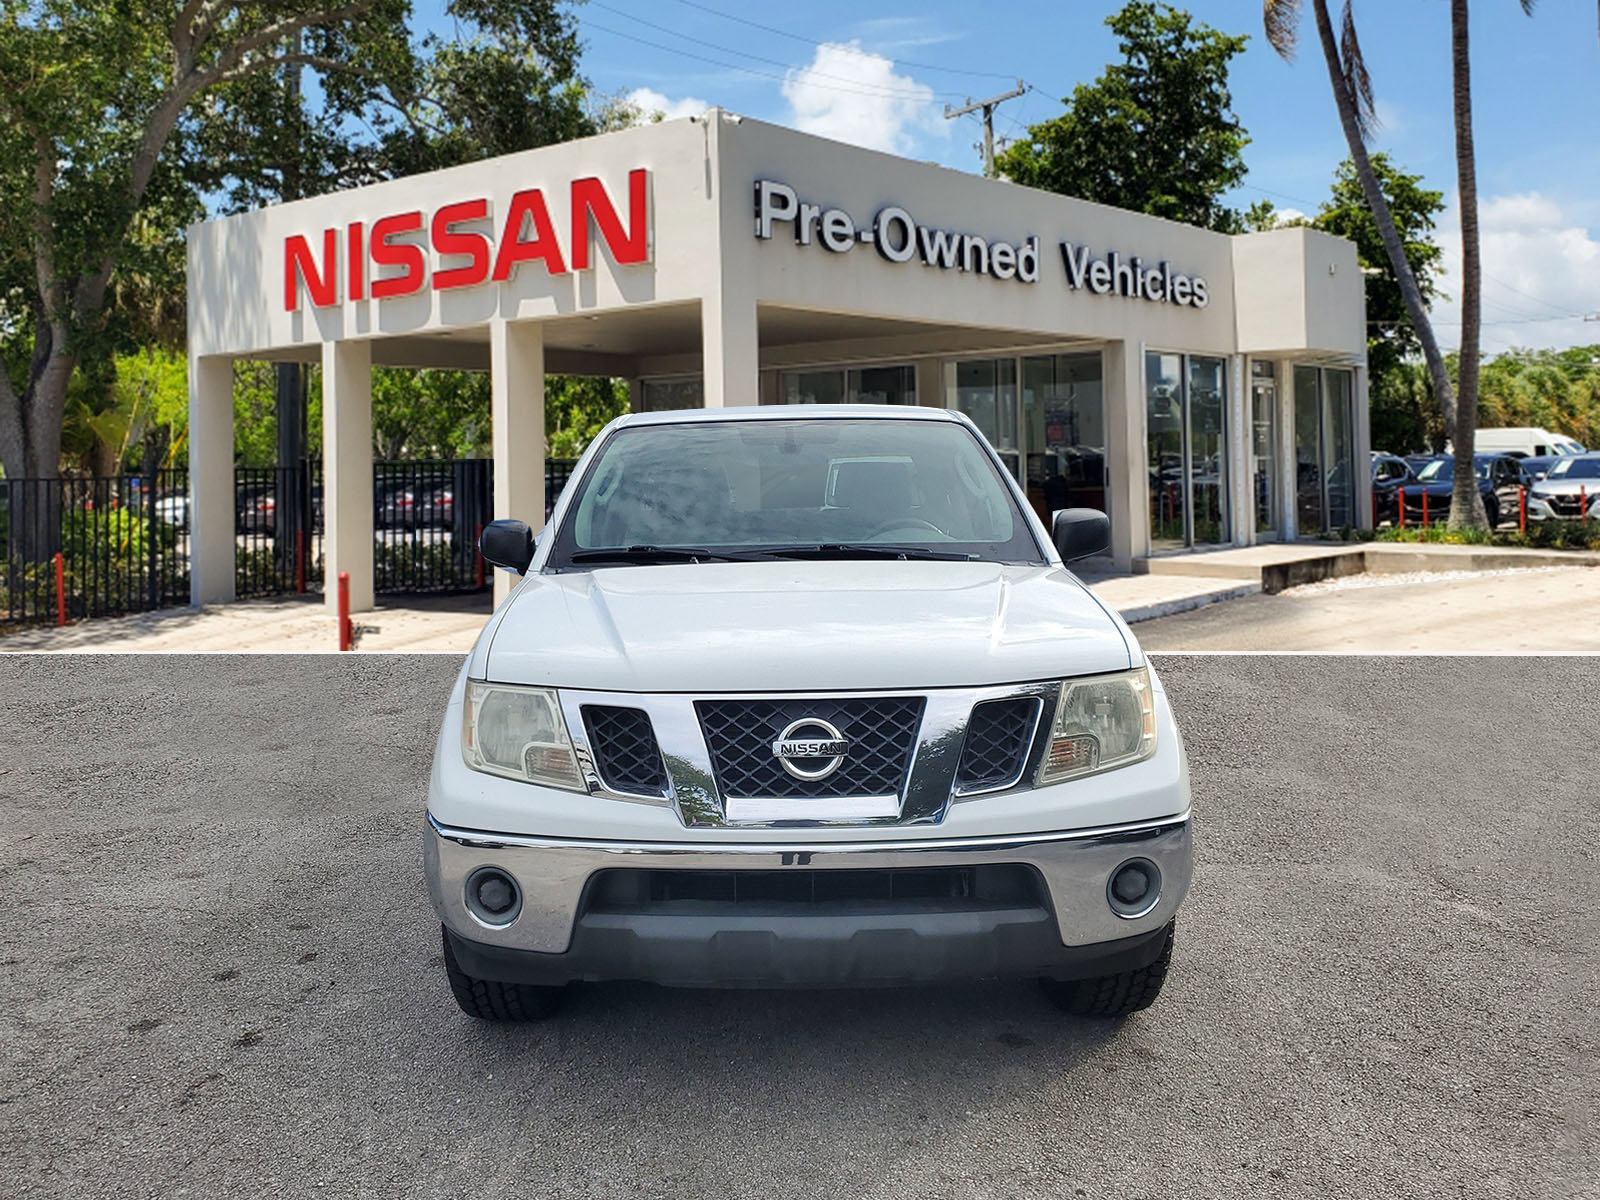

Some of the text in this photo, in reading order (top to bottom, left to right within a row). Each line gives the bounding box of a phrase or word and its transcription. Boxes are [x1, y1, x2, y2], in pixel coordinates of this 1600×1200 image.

[284, 168, 648, 312] NISSAN
[755, 180, 1209, 308] Pre-Owned Vehicles
[780, 742, 842, 755] NISSAN
